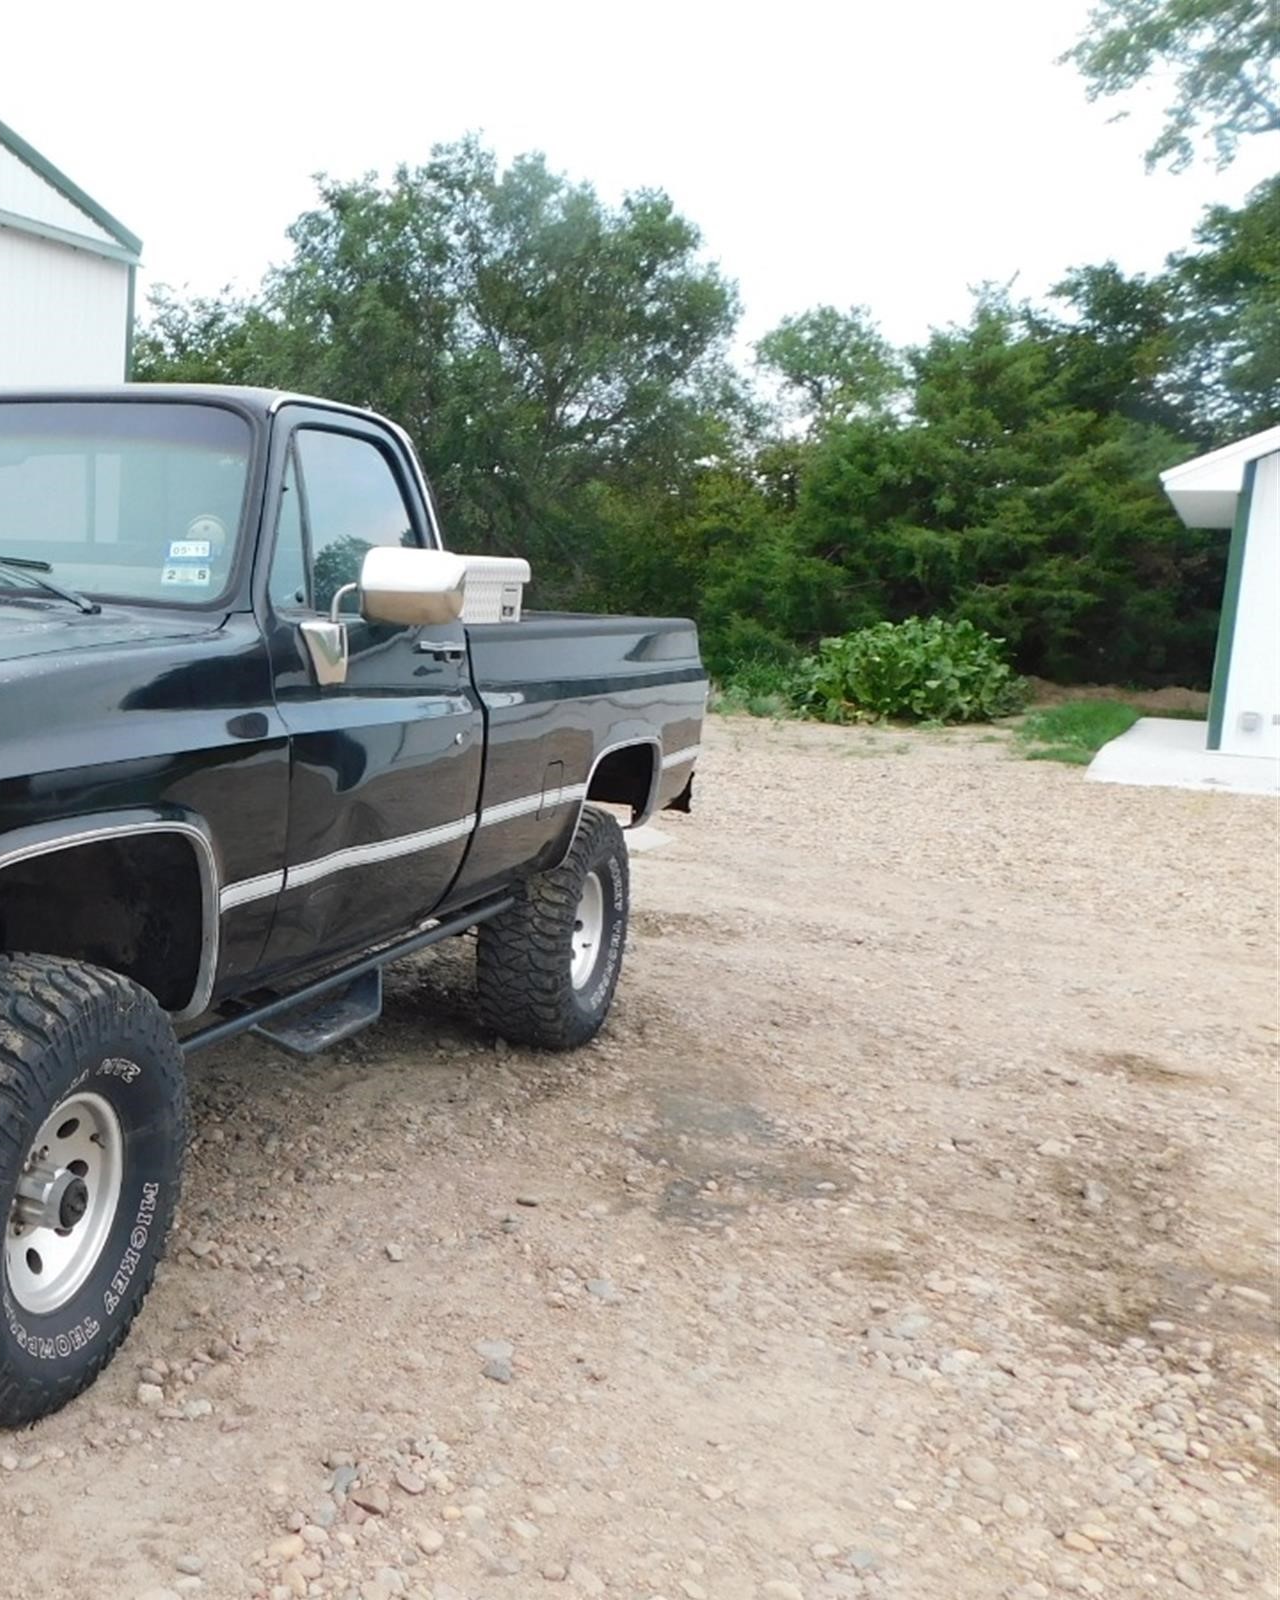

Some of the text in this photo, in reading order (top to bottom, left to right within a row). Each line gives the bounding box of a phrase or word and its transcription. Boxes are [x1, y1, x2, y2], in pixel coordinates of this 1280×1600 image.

[167, 570, 207, 580] 2 5
[104, 1183, 159, 1315] MICKEY
